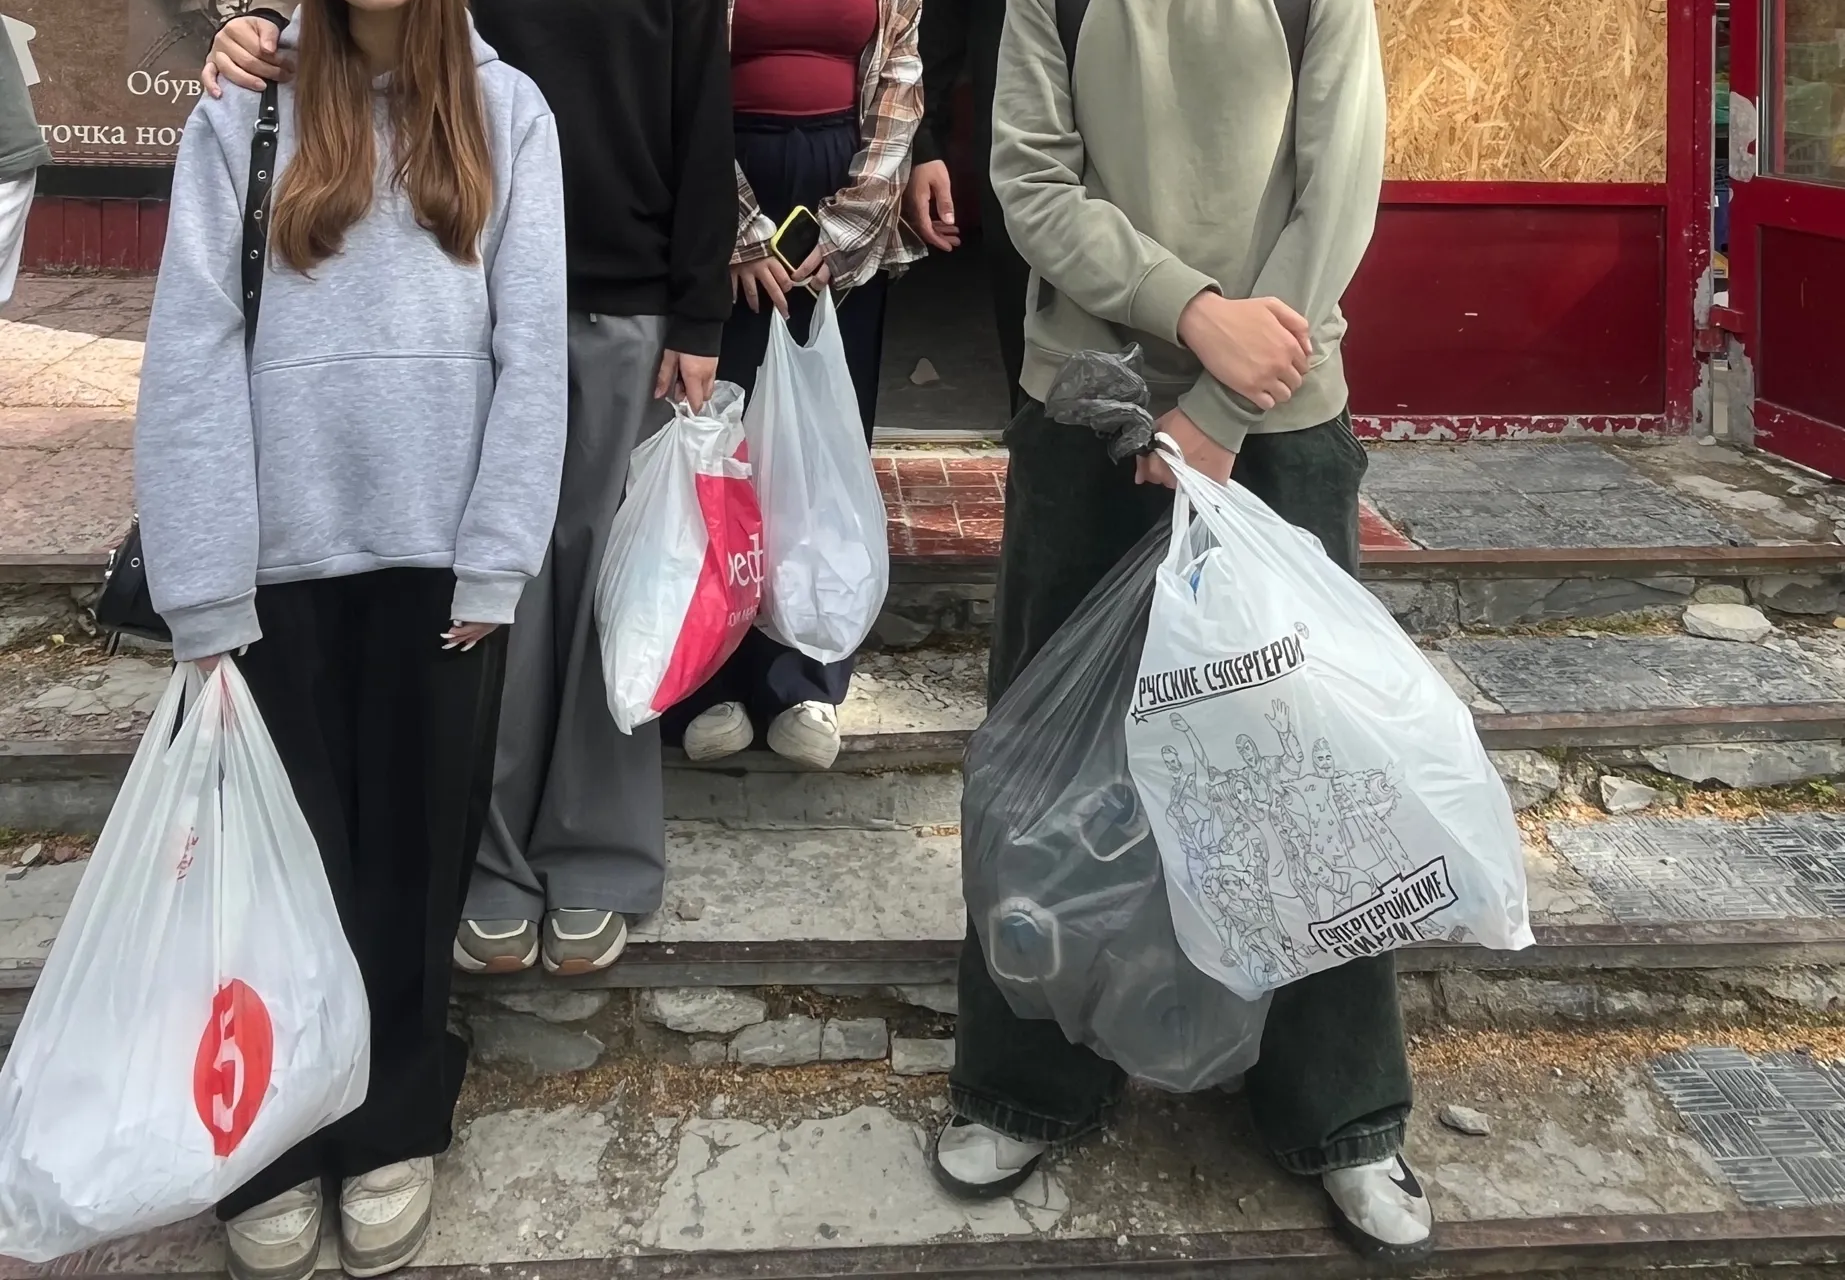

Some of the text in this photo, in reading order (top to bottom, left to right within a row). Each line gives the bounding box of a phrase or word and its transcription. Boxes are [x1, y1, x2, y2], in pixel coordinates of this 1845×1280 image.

[127, 70, 202, 104] Обув
[135, 126, 184, 147] но
[1139, 666, 1204, 708] РУССКИЕ
[1317, 870, 1446, 947] СУПЕРГЕРОЙСКИЕ
